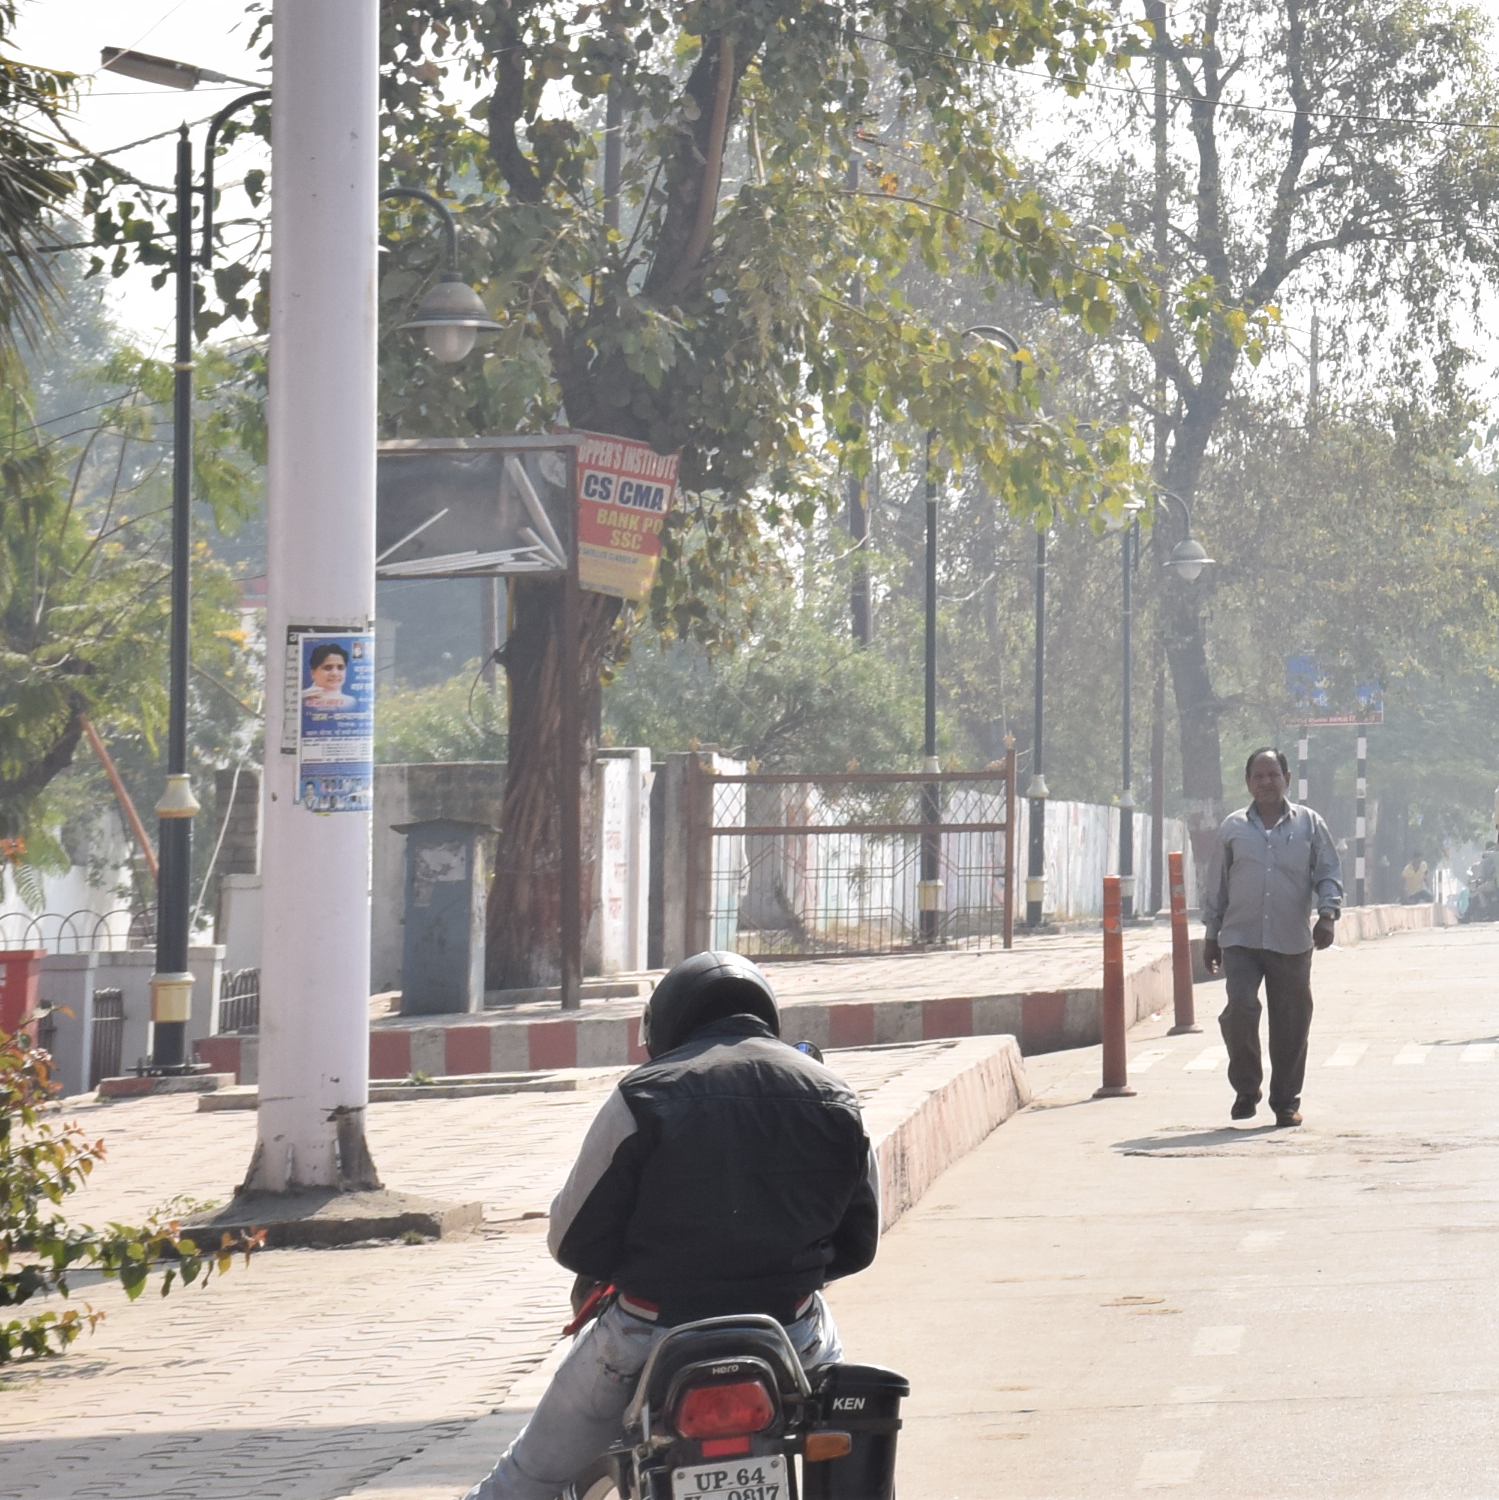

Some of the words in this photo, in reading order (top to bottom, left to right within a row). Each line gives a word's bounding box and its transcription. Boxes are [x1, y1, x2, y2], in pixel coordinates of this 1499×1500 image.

[623, 446, 679, 479] INSTITUTE
[584, 474, 612, 501] CS
[618, 481, 664, 511] CMA
[596, 507, 640, 531] BANK
[610, 529, 643, 551] SSC
[711, 1364, 739, 1375] Hero
[832, 1397, 866, 1411] KEN
